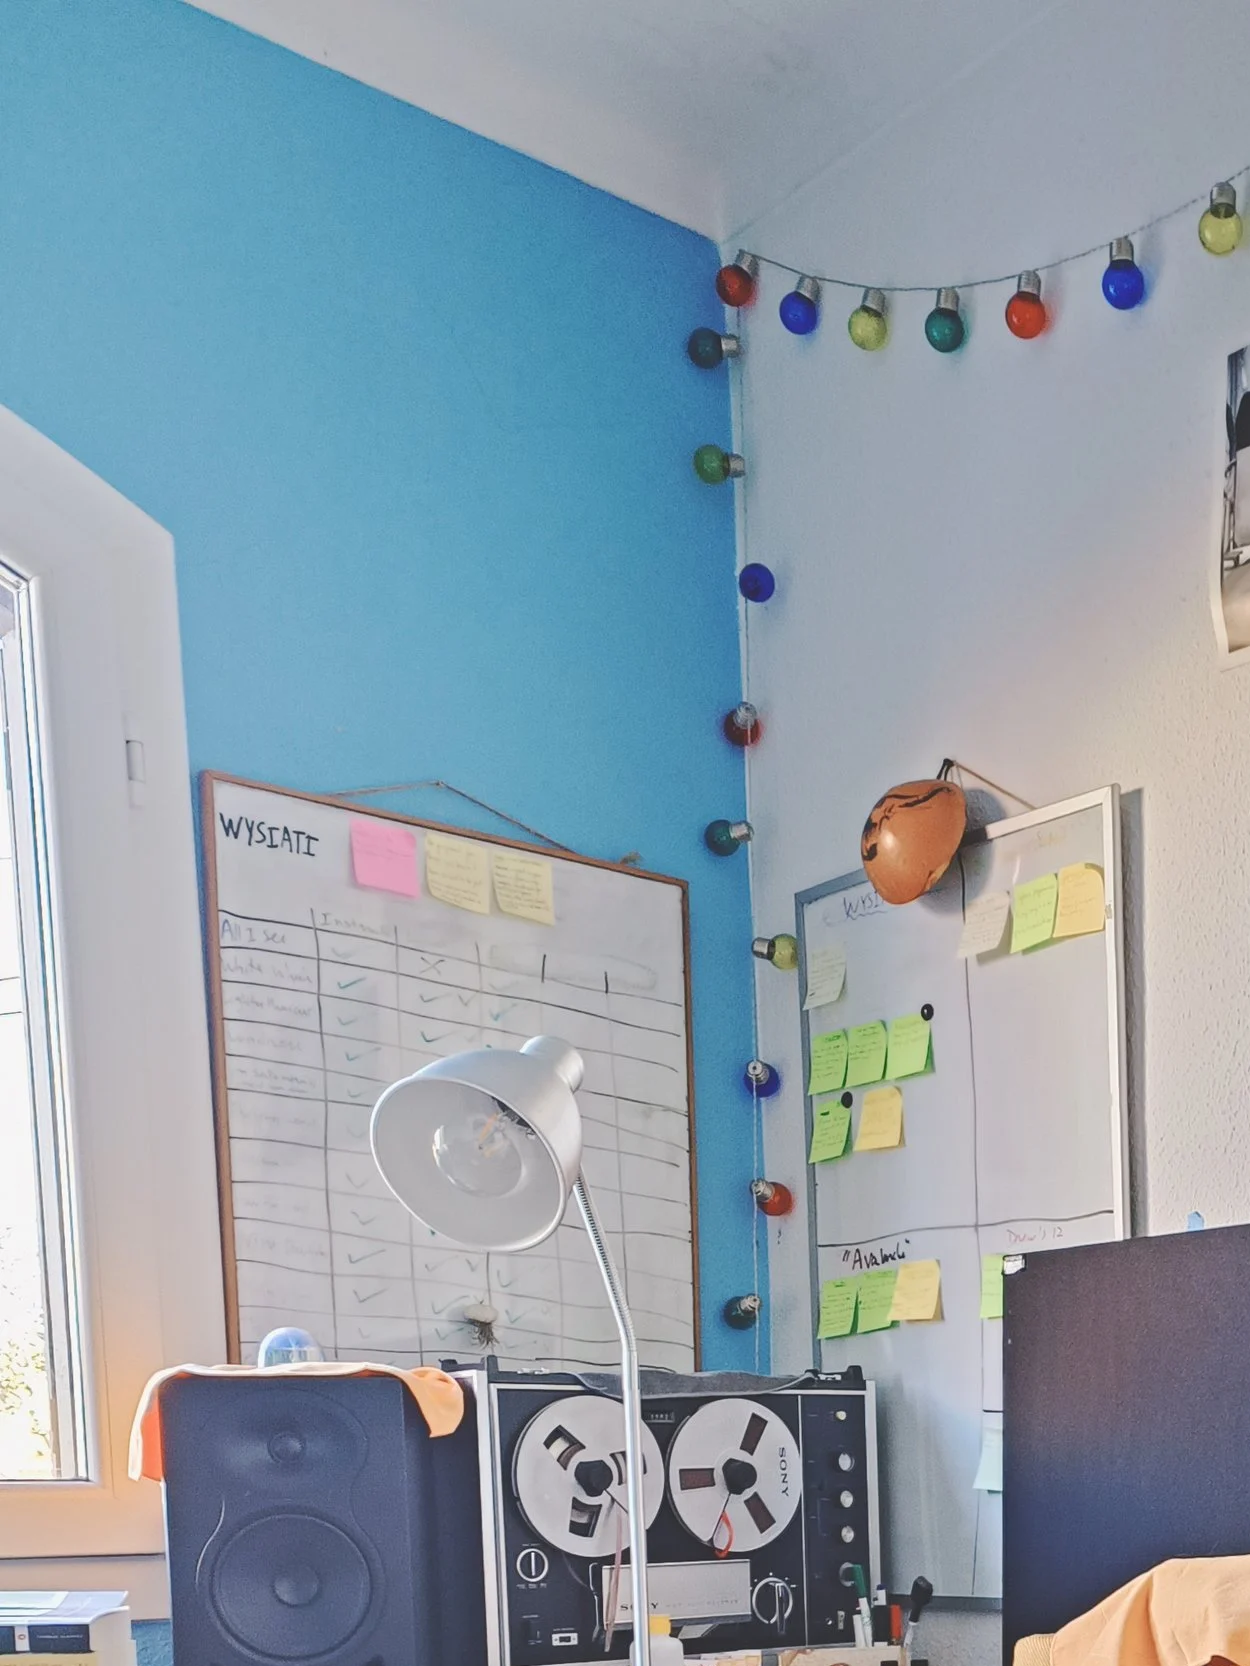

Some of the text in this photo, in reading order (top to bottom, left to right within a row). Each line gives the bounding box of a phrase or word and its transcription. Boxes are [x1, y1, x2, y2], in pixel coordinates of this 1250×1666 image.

[219, 812, 319, 857] WYSIATI
[778, 1447, 789, 1497] SONY
[620, 1601, 659, 1611] SY
